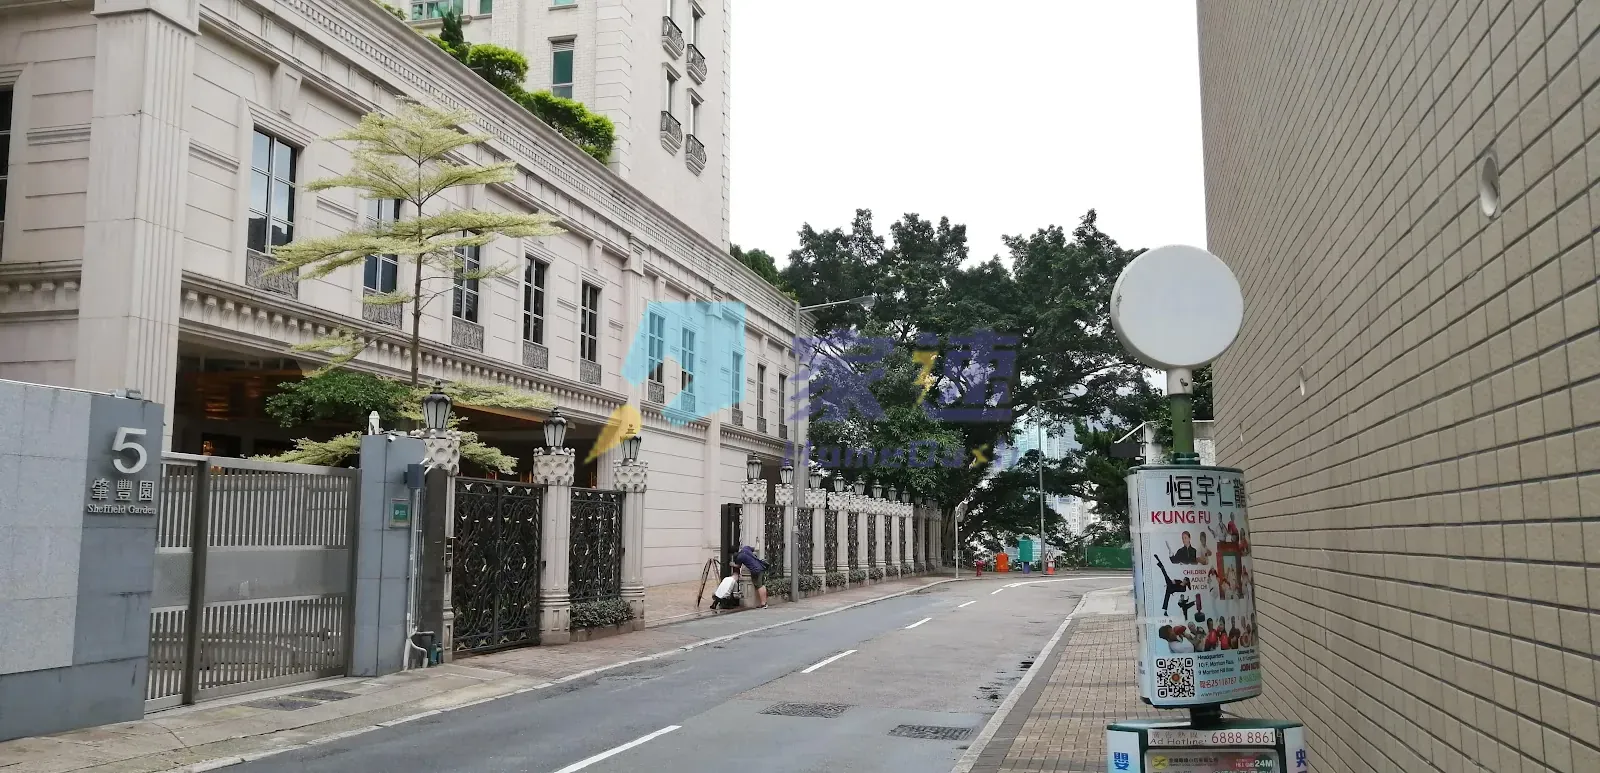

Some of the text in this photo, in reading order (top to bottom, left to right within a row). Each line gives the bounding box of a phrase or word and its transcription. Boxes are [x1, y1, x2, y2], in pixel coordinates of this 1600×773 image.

[111, 426, 148, 474] 5
[92, 478, 154, 502] 肇豐園
[87, 503, 157, 515] Sheffield Garden
[1151, 510, 1211, 525] KUNG FU
[1212, 731, 1243, 744] 6888
[1247, 731, 1275, 744] 8861
[1255, 759, 1273, 767] 24M
